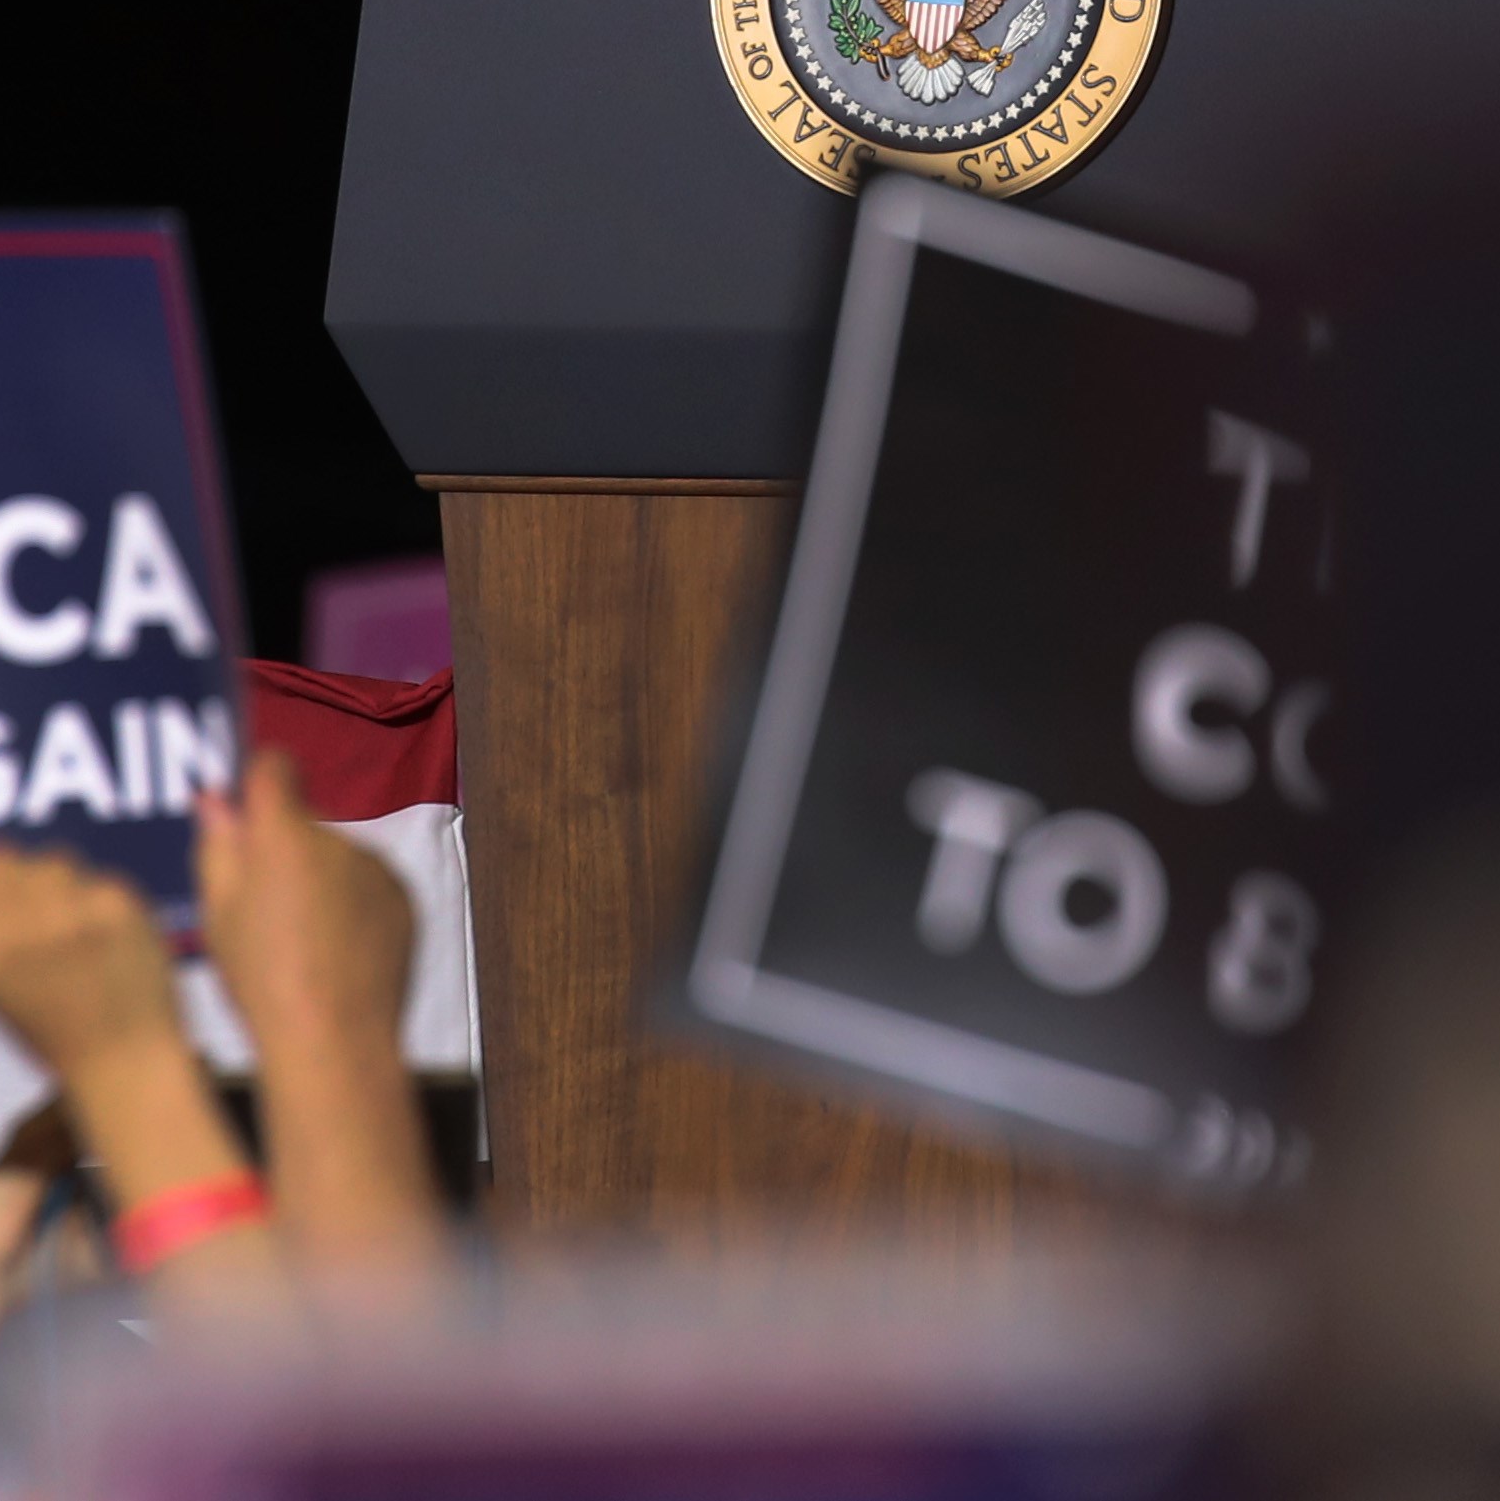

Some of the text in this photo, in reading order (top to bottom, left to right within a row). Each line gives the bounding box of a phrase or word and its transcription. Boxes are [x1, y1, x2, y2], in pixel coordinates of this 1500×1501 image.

[740, 40, 774, 81] OF
[956, 63, 1118, 192] STATES
[904, 763, 1170, 997] TO
